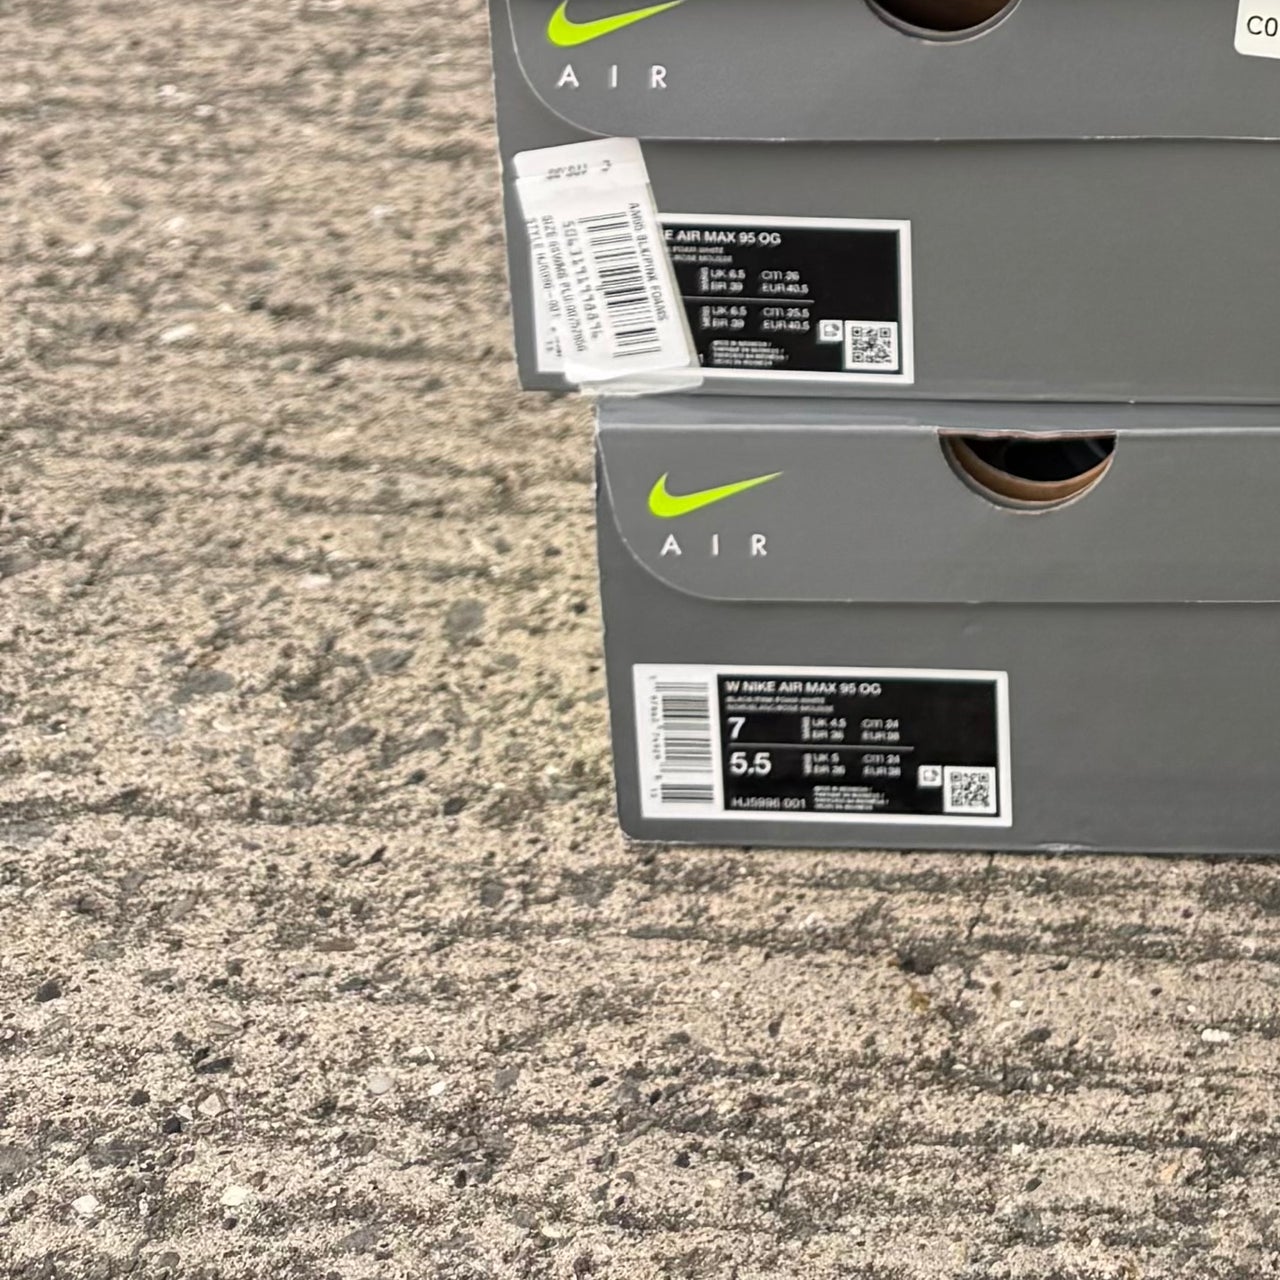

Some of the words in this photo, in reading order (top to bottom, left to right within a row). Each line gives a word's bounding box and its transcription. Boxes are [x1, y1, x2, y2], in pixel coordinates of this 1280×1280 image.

[556, 63, 668, 89] AIR
[677, 230, 700, 241] AIR
[704, 231, 736, 243] MAX
[739, 232, 756, 244] 95
[758, 233, 781, 245] OG
[660, 533, 768, 556] AIR
[725, 681, 741, 692] W
[743, 681, 776, 693] NIKE
[779, 682, 802, 693] AIR
[806, 682, 836, 694] MAX
[839, 683, 857, 695] 95
[859, 683, 881, 695] OG
[728, 717, 746, 739] 7
[729, 752, 772, 775] 5.5
